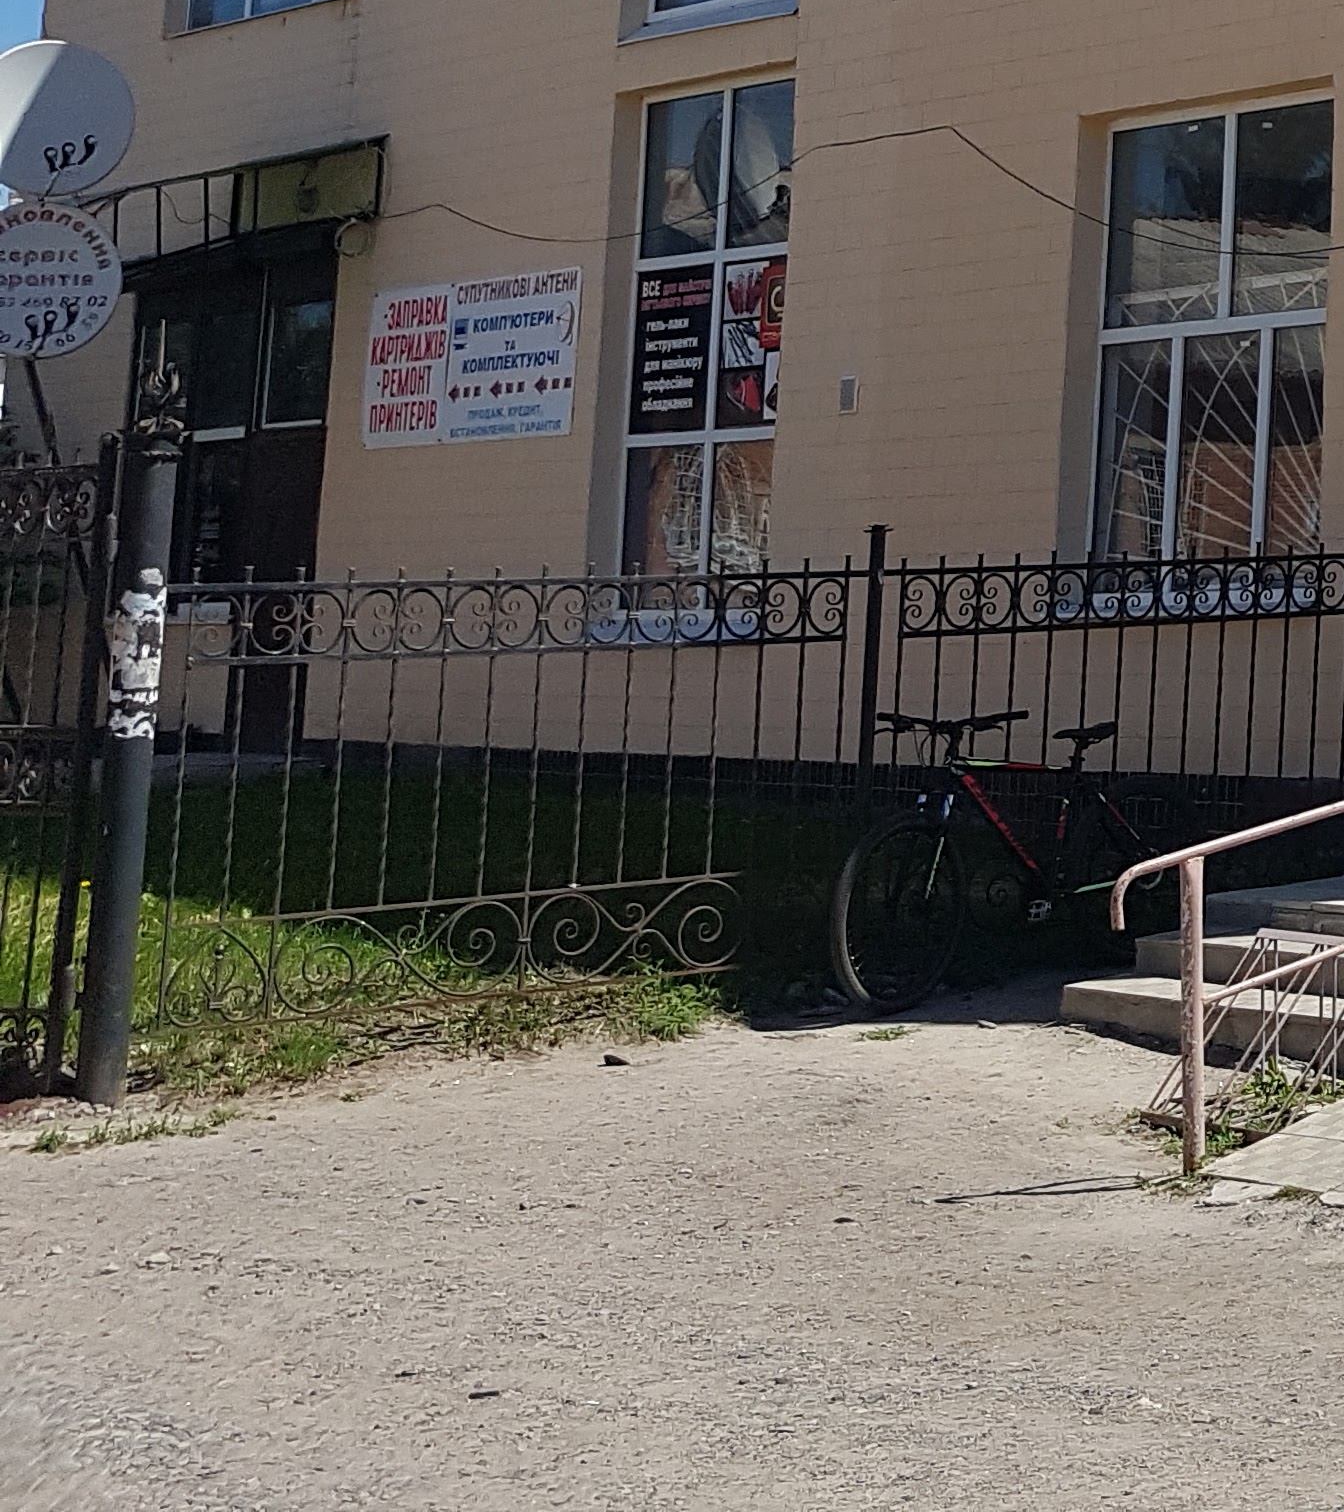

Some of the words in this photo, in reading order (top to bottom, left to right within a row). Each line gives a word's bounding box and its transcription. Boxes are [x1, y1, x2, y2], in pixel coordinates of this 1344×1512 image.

[0, 209, 112, 271] новлення
[87, 295, 109, 308] 02
[456, 276, 532, 305] СУПУТНИКОВІ
[532, 270, 579, 296] АНТЕНИ
[642, 279, 662, 298] ВСЕ
[387, 295, 448, 331] ЗАПРАВКА
[472, 309, 554, 334] КОМП'ЮТЕРИ
[370, 330, 447, 366] КАРТРИДЖІВ
[461, 349, 560, 374] КОМПЛЕКТУЮЧІ
[504, 340, 516, 352] ТА
[381, 365, 433, 399] РЕМОНТ
[369, 399, 438, 433] ПРИНТЕРІВ
